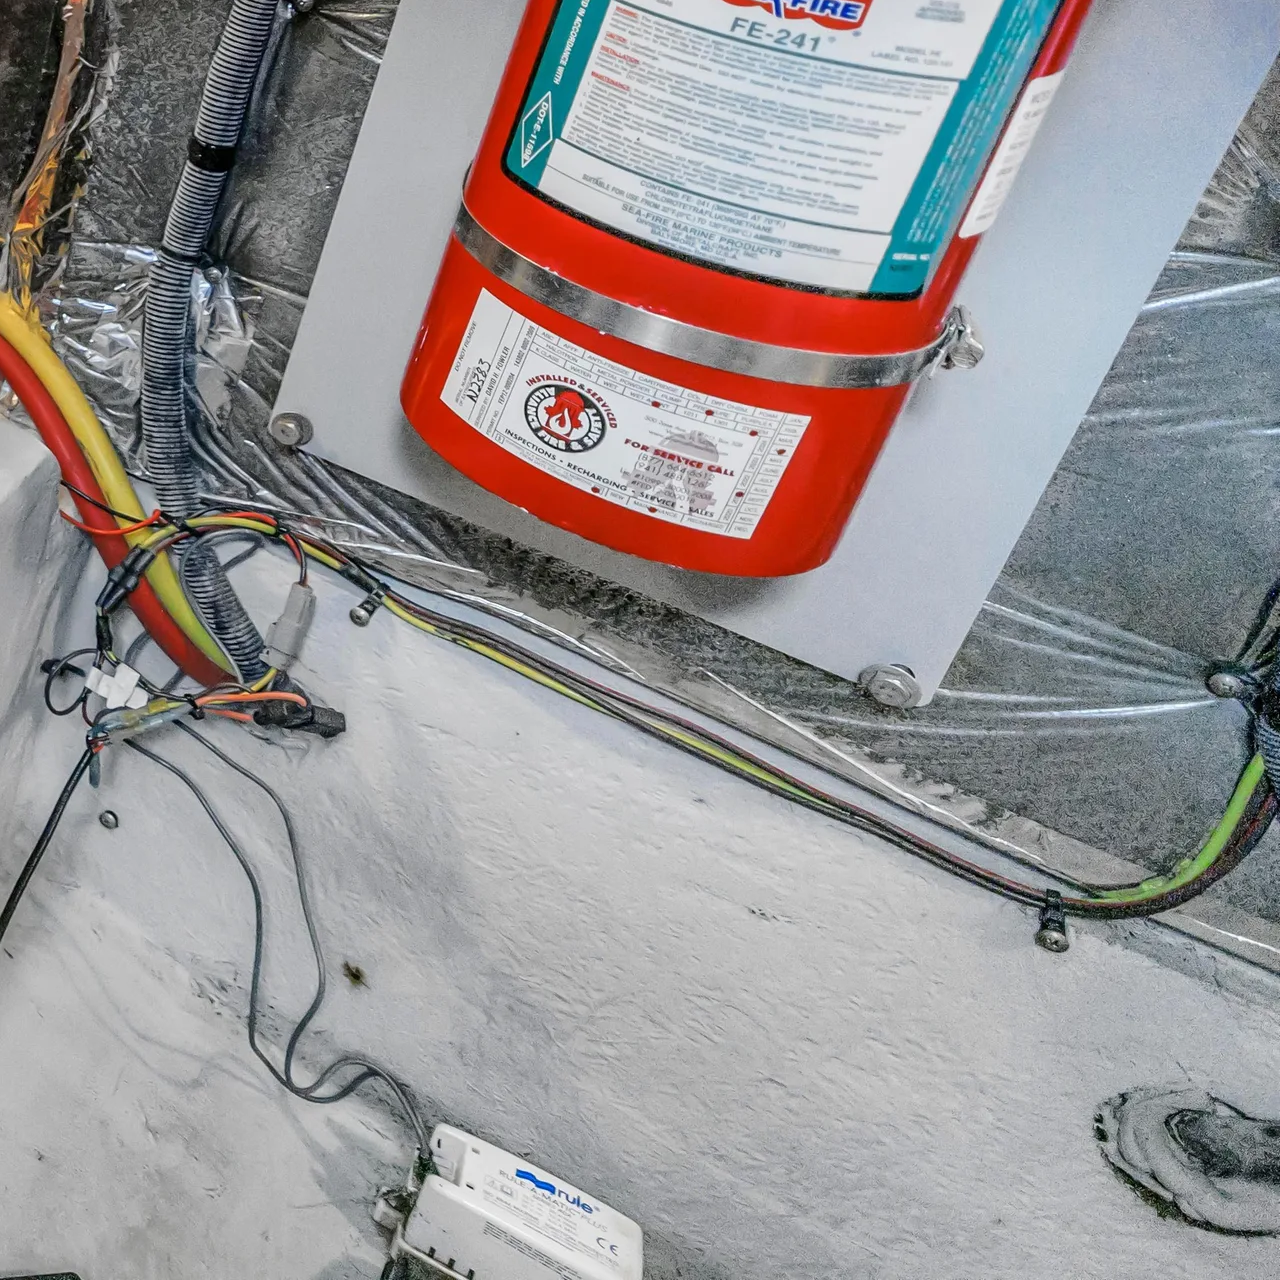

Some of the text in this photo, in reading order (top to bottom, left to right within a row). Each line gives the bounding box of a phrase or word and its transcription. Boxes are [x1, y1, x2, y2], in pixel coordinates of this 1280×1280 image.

[576, 6, 586, 16] IN
[557, 14, 583, 66] ACCORDANCE
[730, 16, 821, 54] FE-241
[551, 64, 565, 85] WITH
[609, 186, 625, 197] FOR
[624, 191, 639, 202] USE
[639, 179, 679, 199] CONTAINS
[620, 202, 670, 227] SEA-FIRE
[670, 221, 716, 241] MARINE
[718, 235, 782, 258] PRODUCTS
[453, 320, 478, 372] DO NOT REMOVE
[495, 345, 510, 371] FOWLER
[492, 370, 500, 379] H.
[484, 378, 497, 396] DAVID
[568, 364, 592, 380] WATER
[601, 379, 619, 392] WET
[644, 396, 670, 411] ANT
[595, 367, 619, 383] METAL
[619, 377, 650, 396] POWDER
[659, 392, 682, 406] PUMP
[525, 374, 618, 429] INSTALLED & SERVICED
[536, 429, 567, 450] FIRE
[623, 438, 650, 452] FOR
[652, 448, 704, 469] SERVICE
[706, 463, 735, 477] CALL
[633, 460, 661, 475] (941)
[637, 451, 665, 467] (877)
[503, 427, 557, 461] INSPECTIONS
[566, 461, 628, 492] RECHARGING
[638, 491, 676, 508] SERVICE
[688, 505, 715, 518] SALES
[555, 1187, 595, 1215] rule
[578, 1213, 609, 1233] PLUS
[593, 1235, 621, 1256] CE
